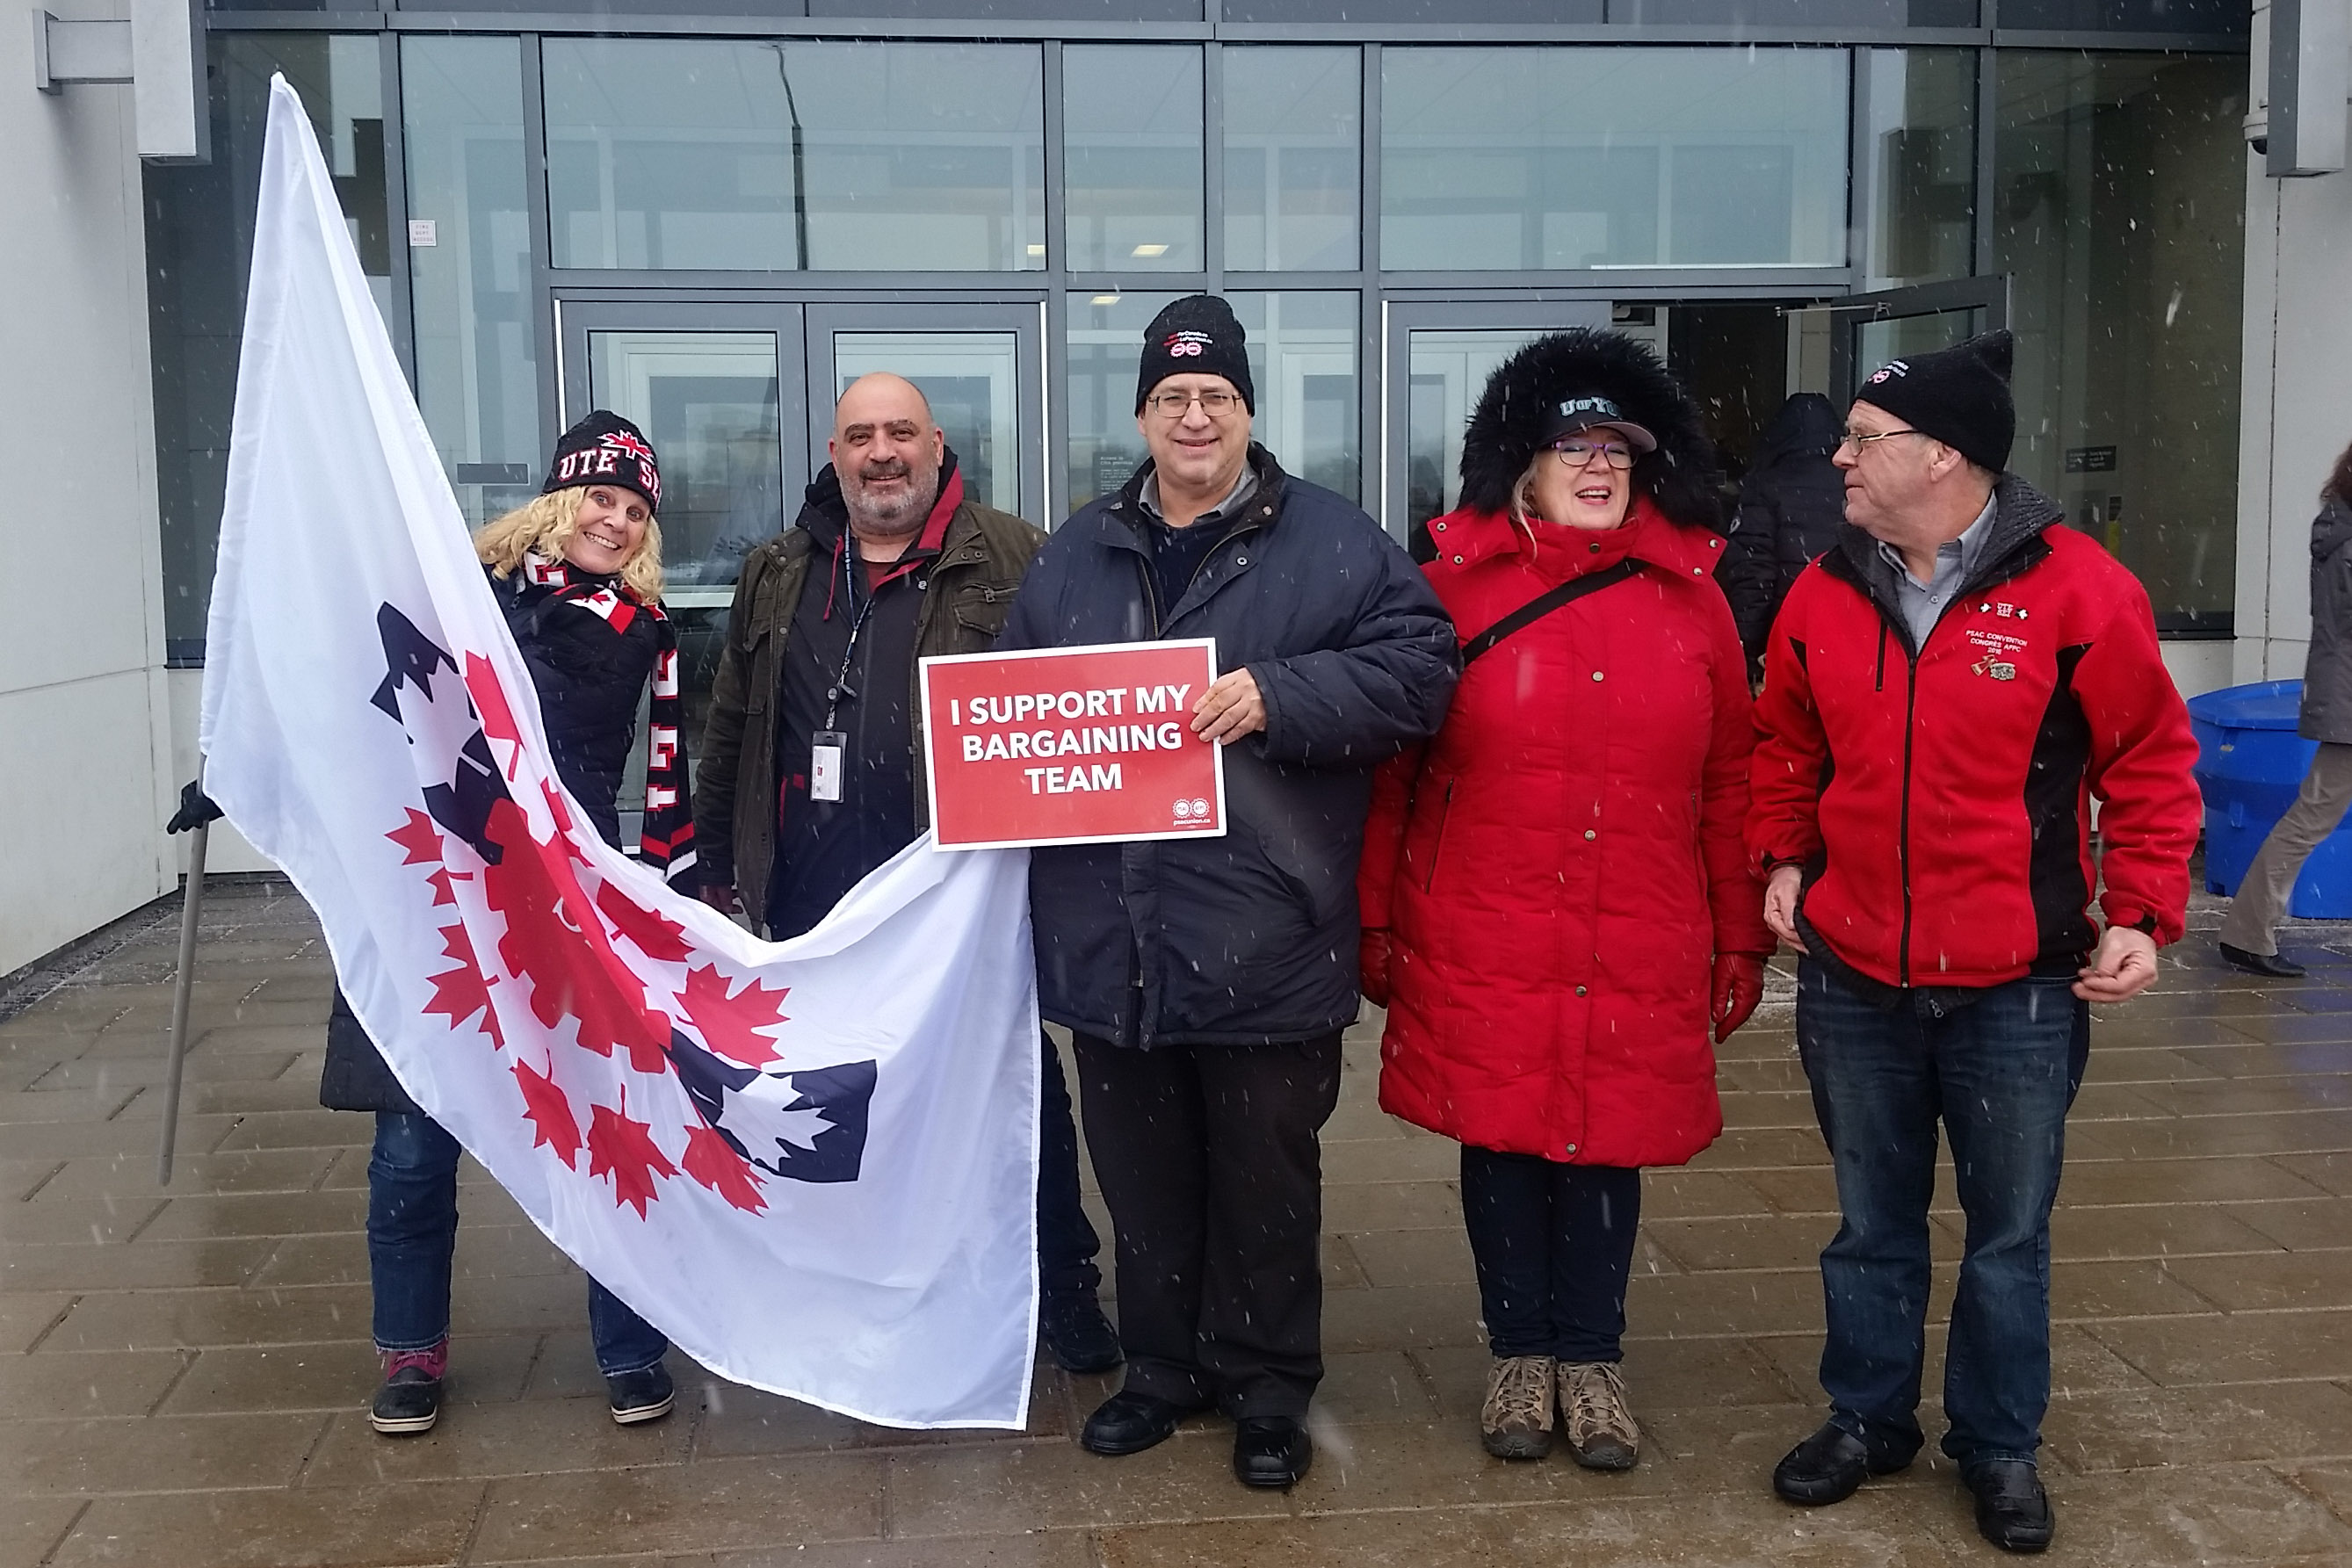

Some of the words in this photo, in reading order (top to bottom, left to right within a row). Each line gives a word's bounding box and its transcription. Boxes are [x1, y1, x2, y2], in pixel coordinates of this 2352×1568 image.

[560, 448, 619, 481] UTE
[1966, 630, 1985, 639] PSAC
[1987, 632, 2028, 647] CONVENTION
[951, 698, 960, 726] I
[969, 688, 1128, 725] SUPPORT
[1135, 683, 1191, 714] MY
[962, 722, 1183, 762] BARGAINING
[1024, 762, 1123, 795] TEAM
